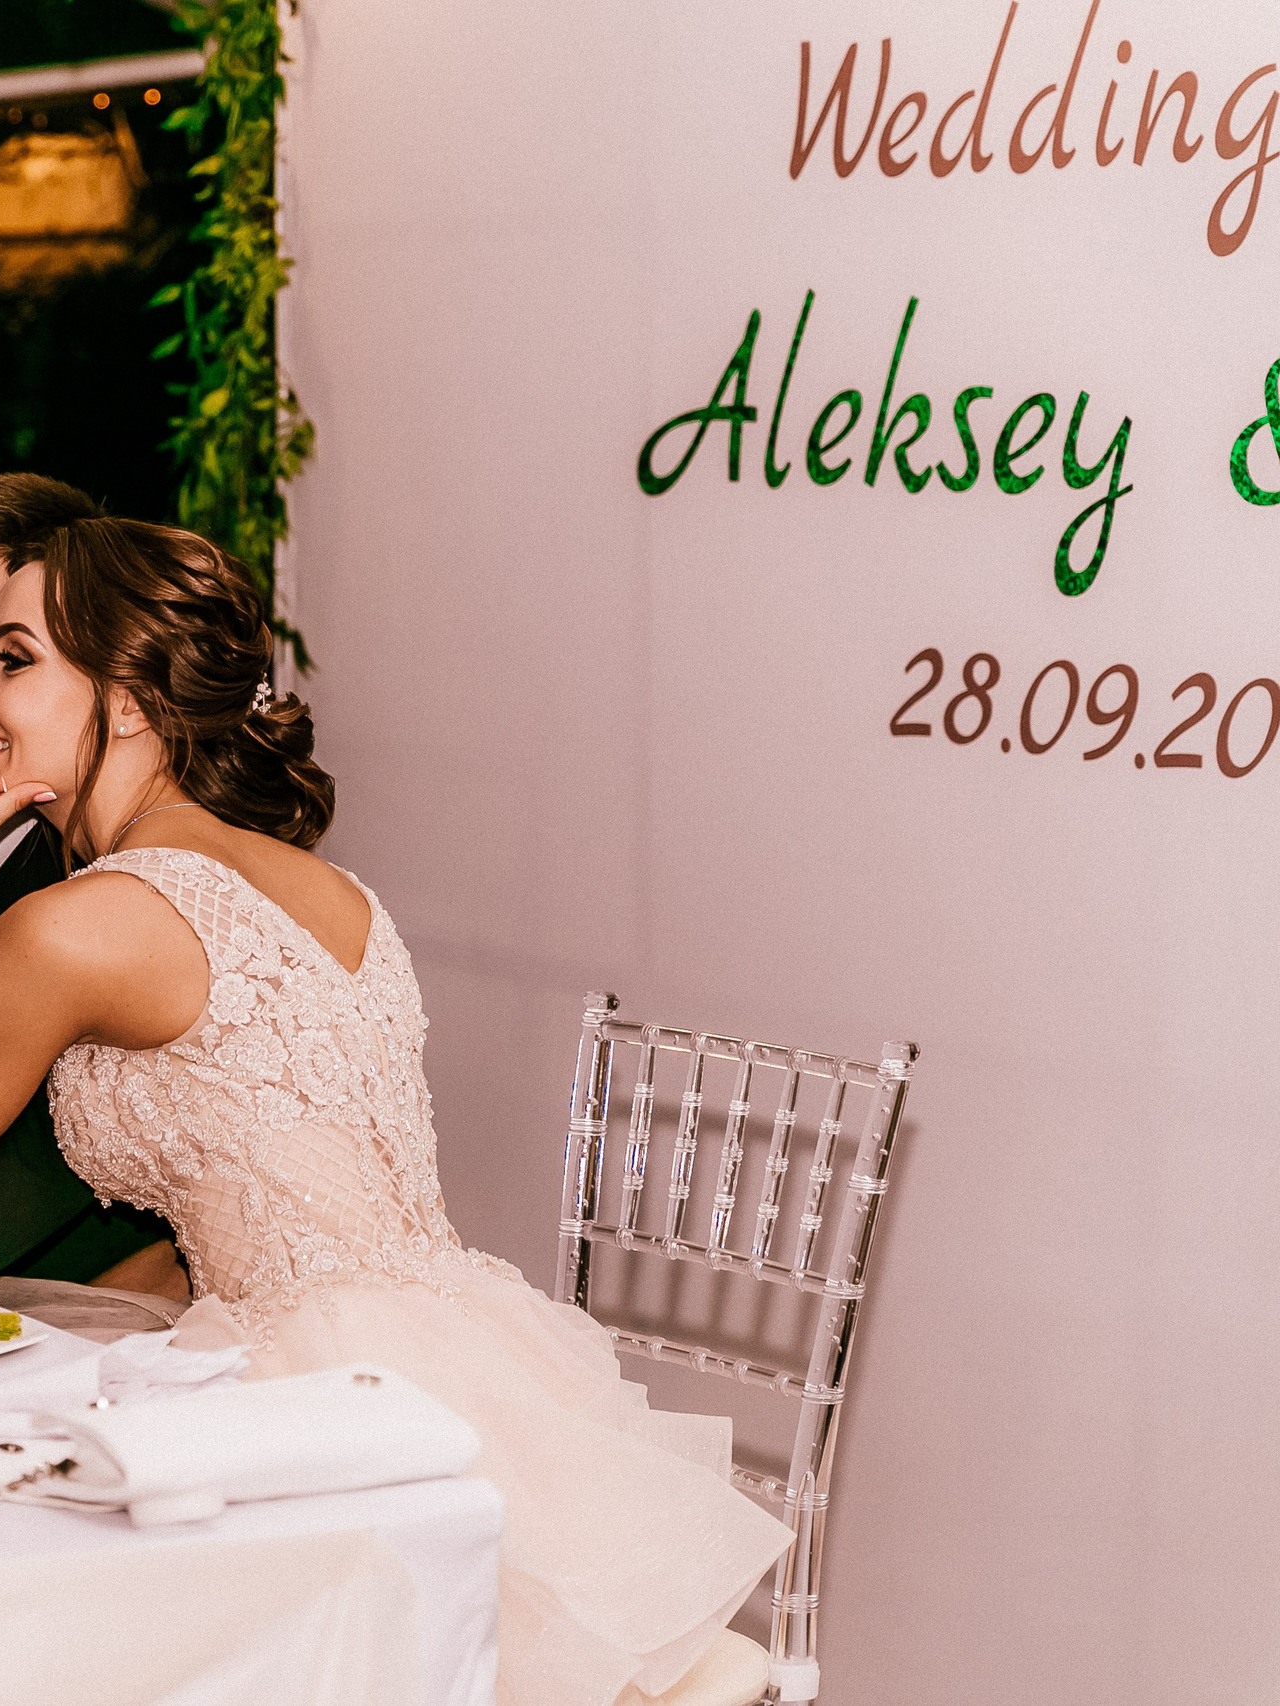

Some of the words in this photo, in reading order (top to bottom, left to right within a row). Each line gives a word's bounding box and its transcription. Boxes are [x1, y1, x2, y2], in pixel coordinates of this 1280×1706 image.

[788, 0, 1280, 257] Wedding
[636, 288, 1134, 598] Aleksey
[889, 647, 1280, 779] 28.09.20
